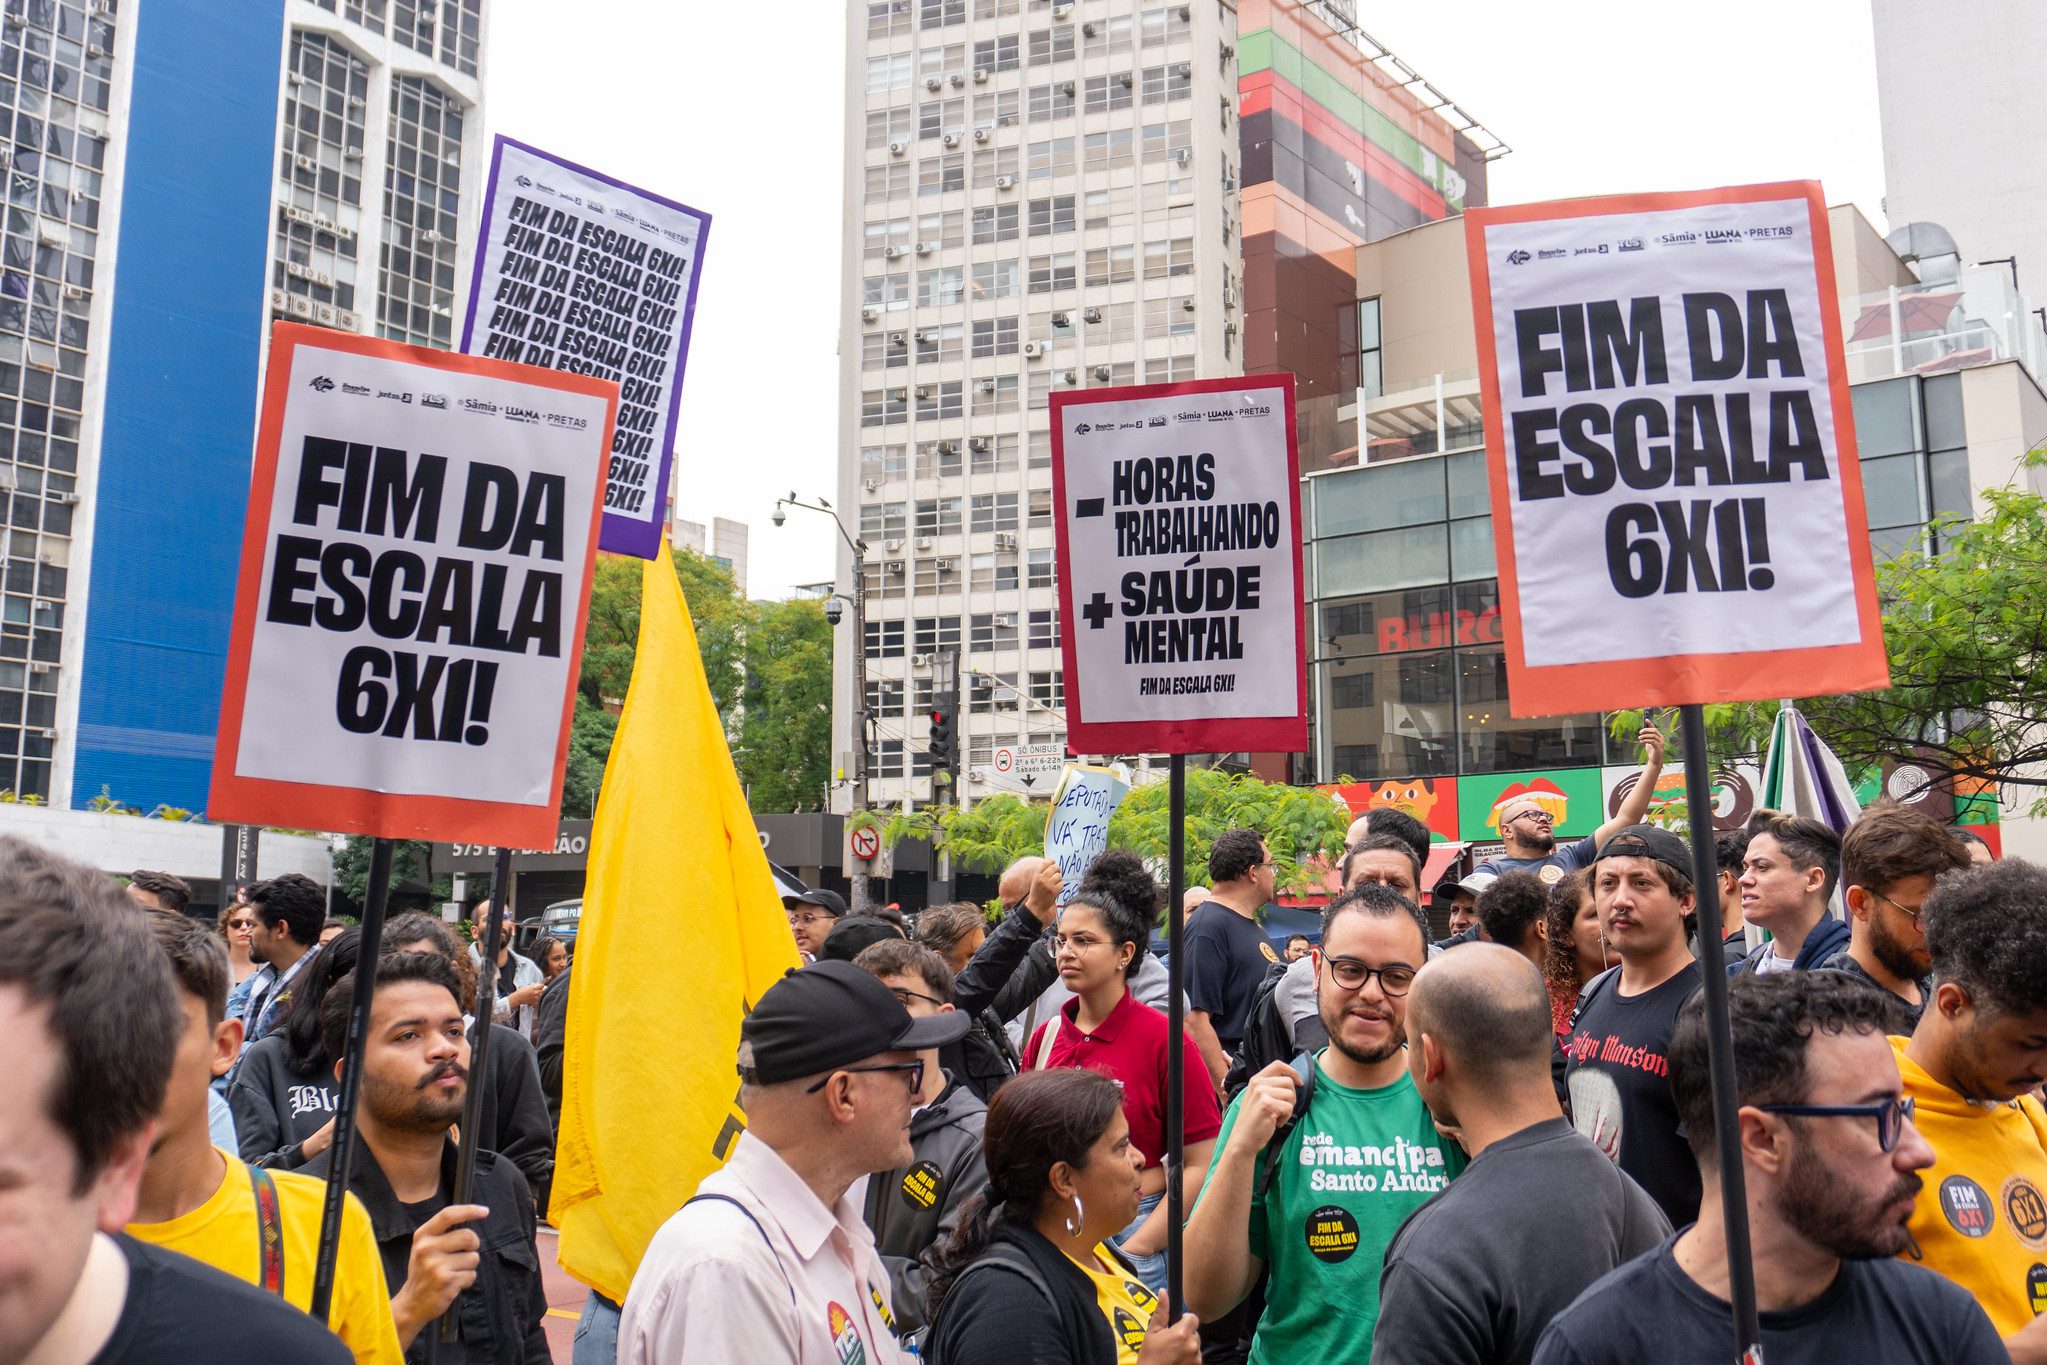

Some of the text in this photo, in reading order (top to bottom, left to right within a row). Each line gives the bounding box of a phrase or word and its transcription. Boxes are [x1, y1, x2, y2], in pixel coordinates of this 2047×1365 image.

[507, 196, 551, 230] FIM
[547, 209, 579, 240] DA
[577, 221, 648, 267] ESCALA
[647, 248, 687, 281] 6X1!
[1661, 231, 1696, 243] Sâmia
[1705, 229, 1742, 239] LUANA
[1749, 226, 1793, 237] PRETAS
[503, 222, 681, 306] FIM DA ESCALA 6X1!
[499, 250, 677, 332] FIM DA ESCALA 6X1!
[494, 277, 672, 357] FIM DA ESCALA 6X1!
[488, 305, 667, 383] FIM DA ESCALA 6X1!
[1513, 287, 1806, 398] FIM DA
[483, 332, 525, 362] FIM
[621, 377, 662, 408] 6X1!
[465, 399, 497, 412] Sâmia
[505, 406, 540, 420] LUANA
[547, 413, 587, 428] PRETAS
[617, 403, 658, 434] 6X1!
[1177, 410, 1201, 420] Sâmia
[1207, 409, 1233, 418] LUANA
[1239, 407, 1270, 416] PRETAS
[611, 429, 654, 460] 6X1!
[1511, 389, 1831, 502] ESCALA
[608, 456, 650, 487] 6X1!
[1112, 452, 1216, 506] HORAS
[293, 435, 567, 562] FIM DA
[604, 483, 647, 513] 6X1!
[1115, 500, 1280, 557] TRABALHANDO
[1604, 496, 1775, 599] 6X1!
[266, 533, 563, 659] ESCALA
[1120, 553, 1261, 617] SAÚDE
[1124, 616, 1243, 664] MENTAL
[336, 646, 499, 747] 6X1!
[1140, 673, 1235, 695] FIM DA ESCALA 6X1!
[1030, 744, 1057, 753] ÔNIBUS
[1053, 818, 1077, 846] VÁ
[239, 861, 247, 878] Av.
[1059, 851, 1081, 877] NÃO
[1600, 1035, 1669, 1077] Manson
[1299, 1136, 1445, 1173] emancipa
[1303, 1132, 1333, 1145] rede
[1311, 1169, 1377, 1191] Santo
[1948, 1185, 1978, 1203] FIM
[1317, 1221, 1344, 1233] FIM DA
[1957, 1209, 1985, 1227] 6X1
[2011, 1194, 2044, 1227] 6X1
[1310, 1234, 1341, 1246] ESCALA
